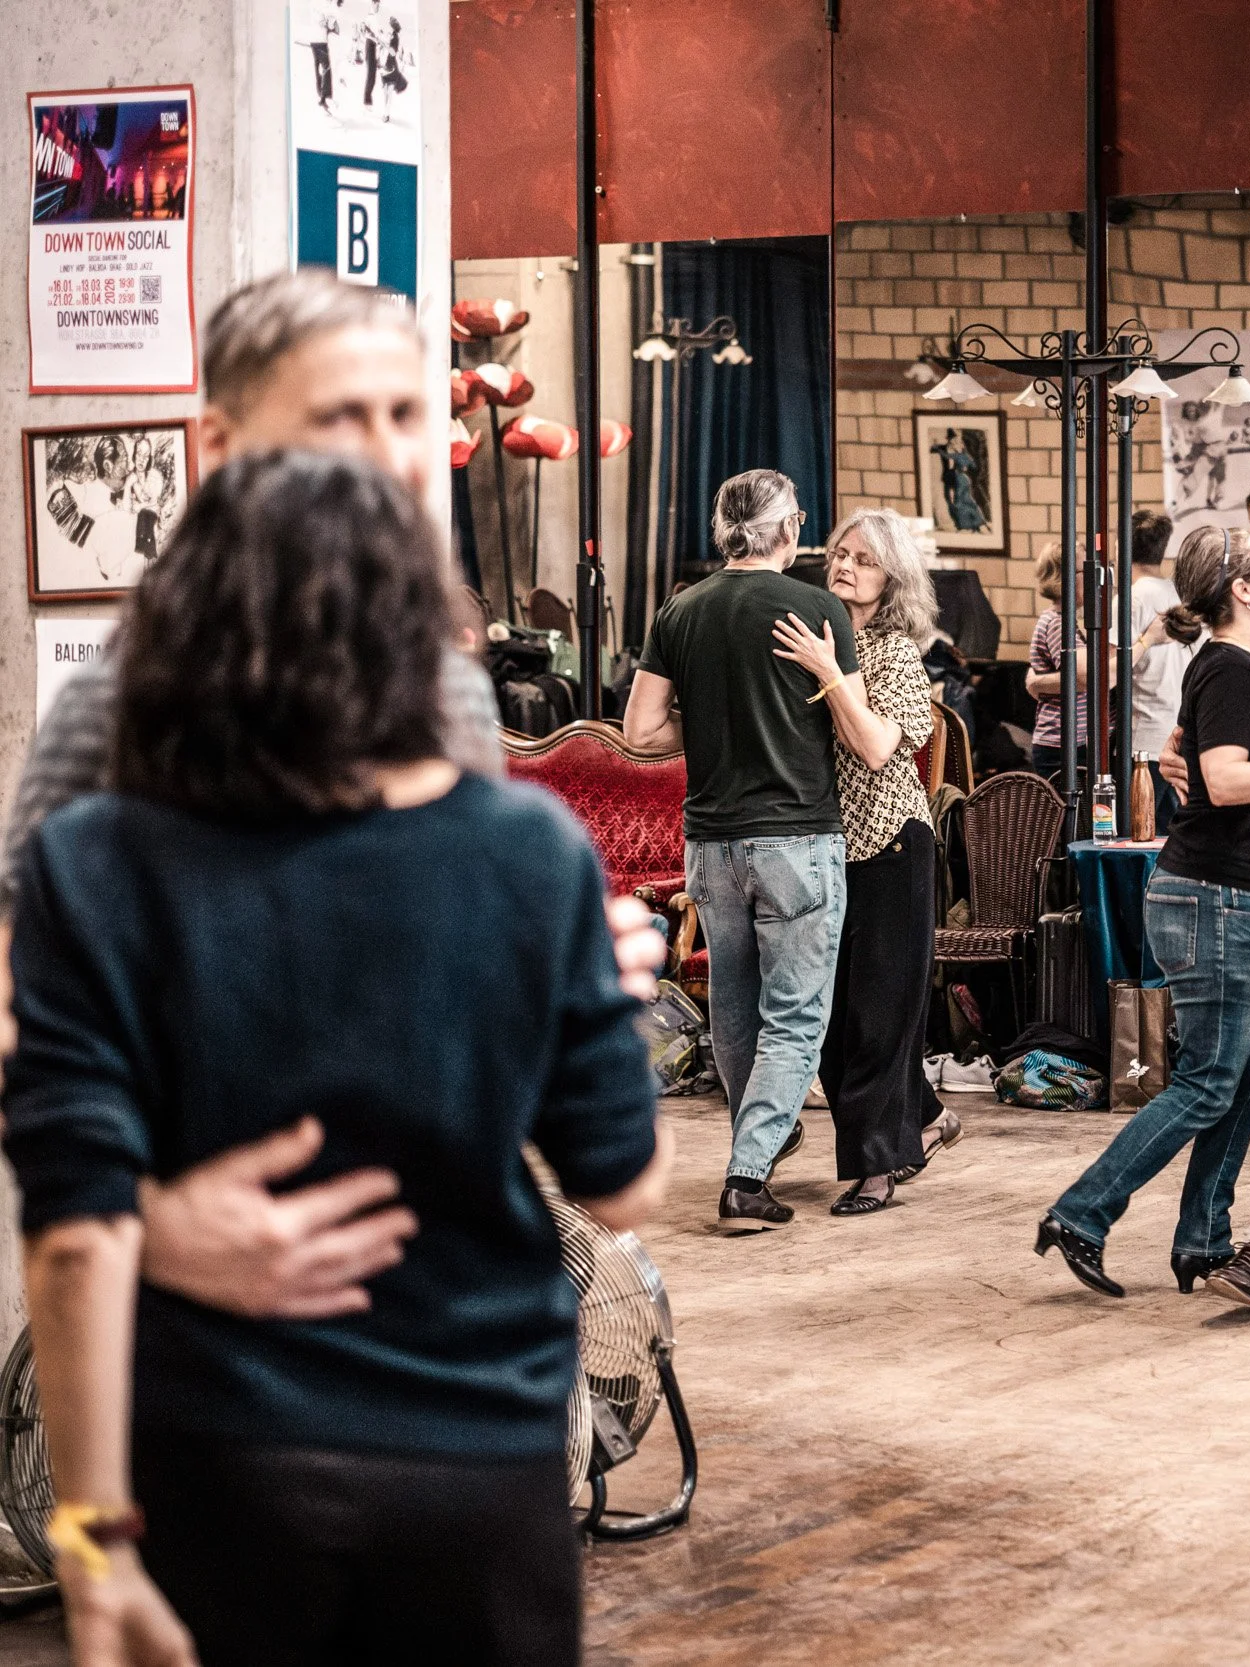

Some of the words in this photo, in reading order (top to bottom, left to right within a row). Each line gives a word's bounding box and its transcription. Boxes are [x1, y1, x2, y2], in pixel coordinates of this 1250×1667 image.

[160, 112, 178, 122] DOWN
[161, 122, 179, 132] TOWN
[45, 232, 83, 253] DOWN
[86, 232, 125, 252] TOWN
[128, 230, 171, 250] SOCIAL
[348, 202, 369, 274] B
[104, 278, 116, 304] 2026
[57, 309, 159, 328] DOWNTOWNSWING
